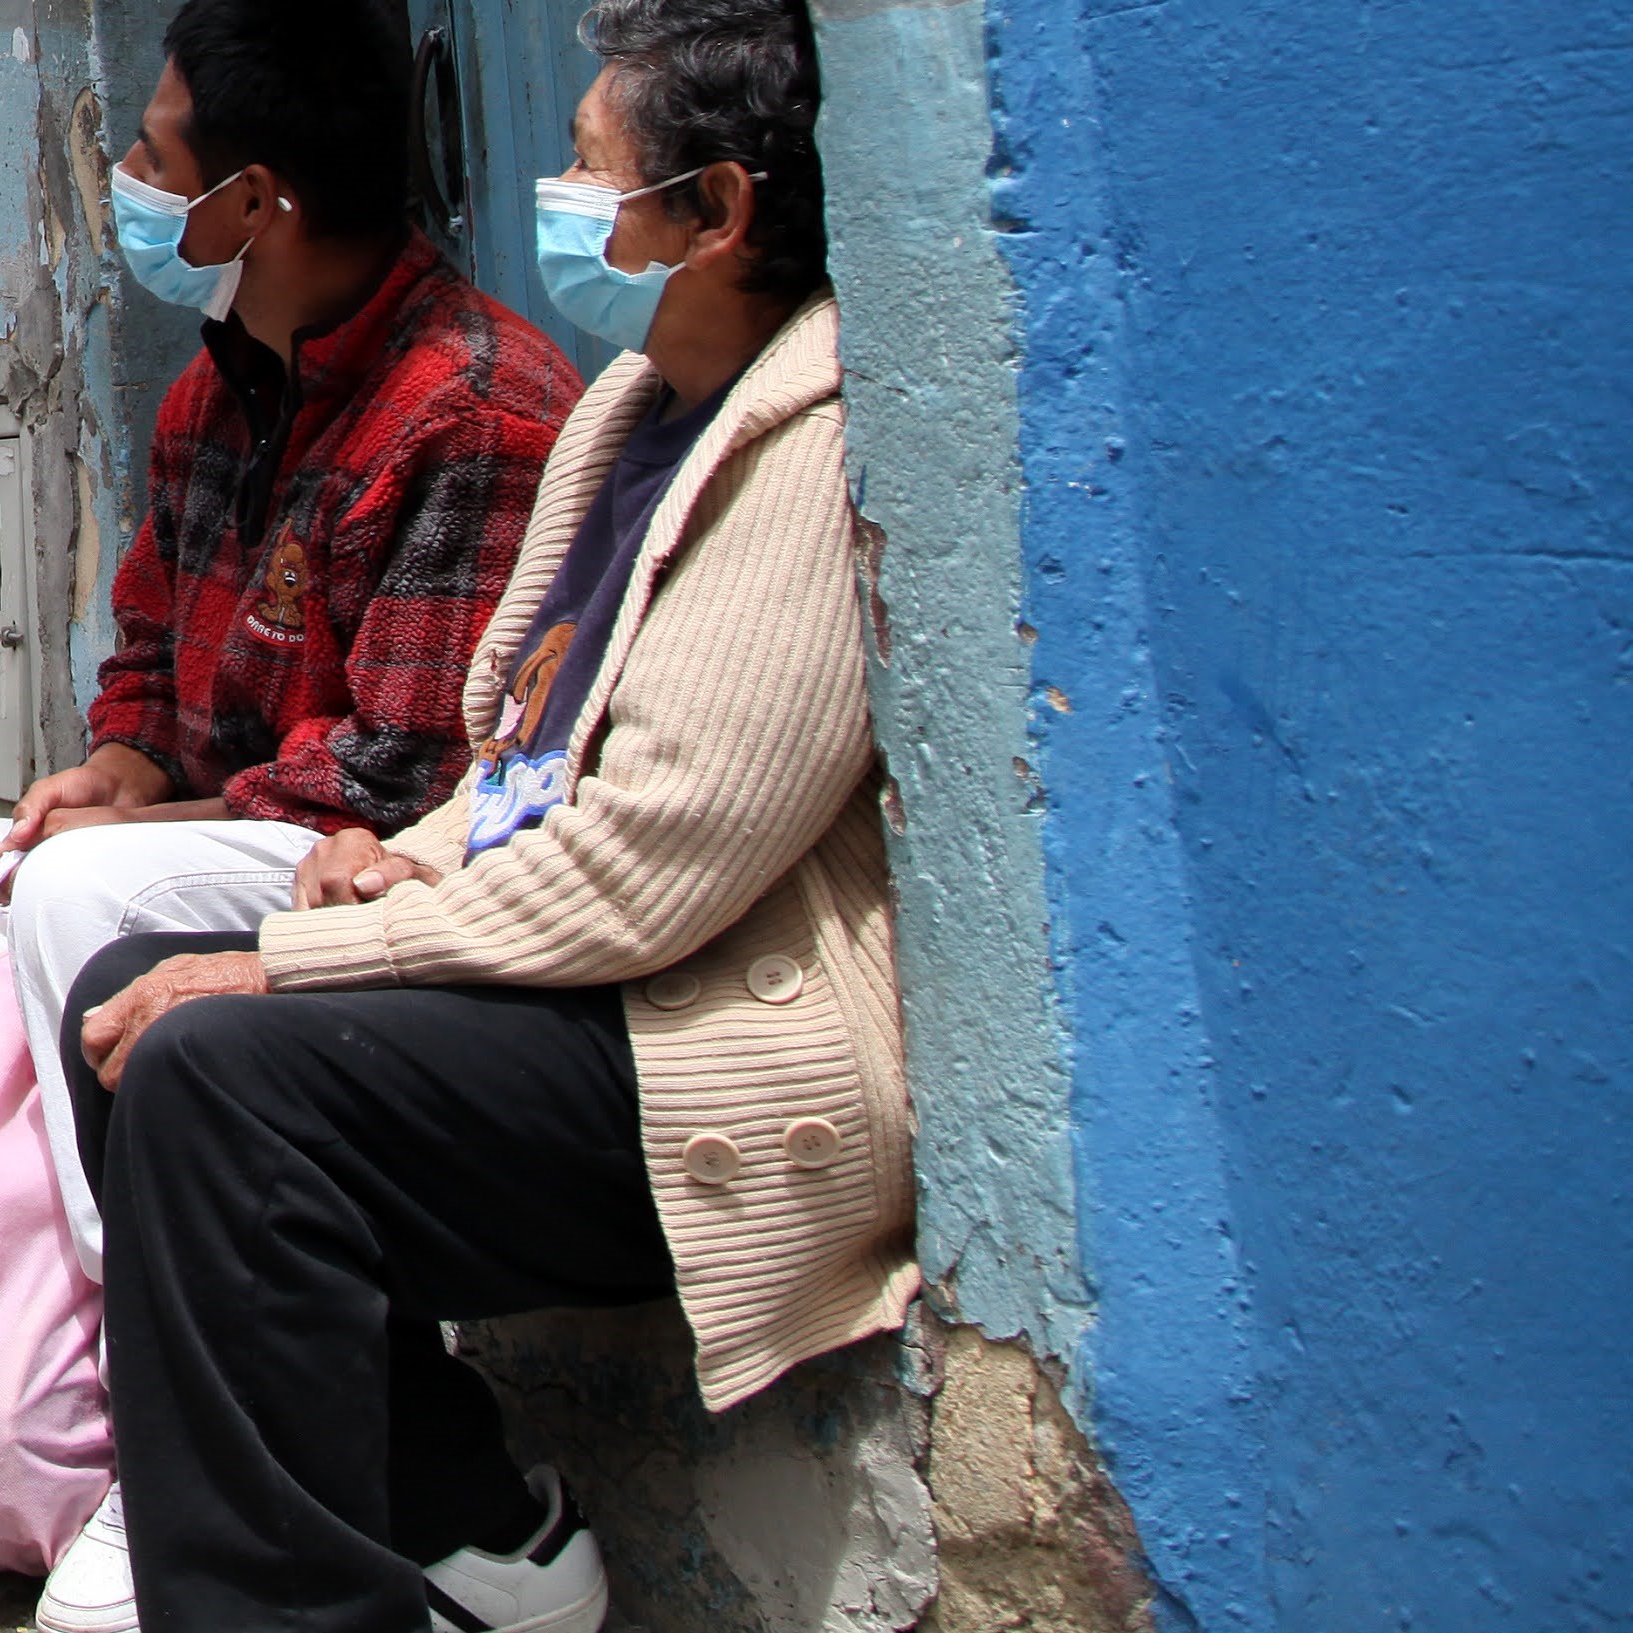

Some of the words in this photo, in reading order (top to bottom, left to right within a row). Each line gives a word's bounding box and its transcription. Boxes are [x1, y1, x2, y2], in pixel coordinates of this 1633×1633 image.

[246, 614, 272, 637] DARE
[271, 630, 286, 641] TO
[288, 633, 305, 643] DO
